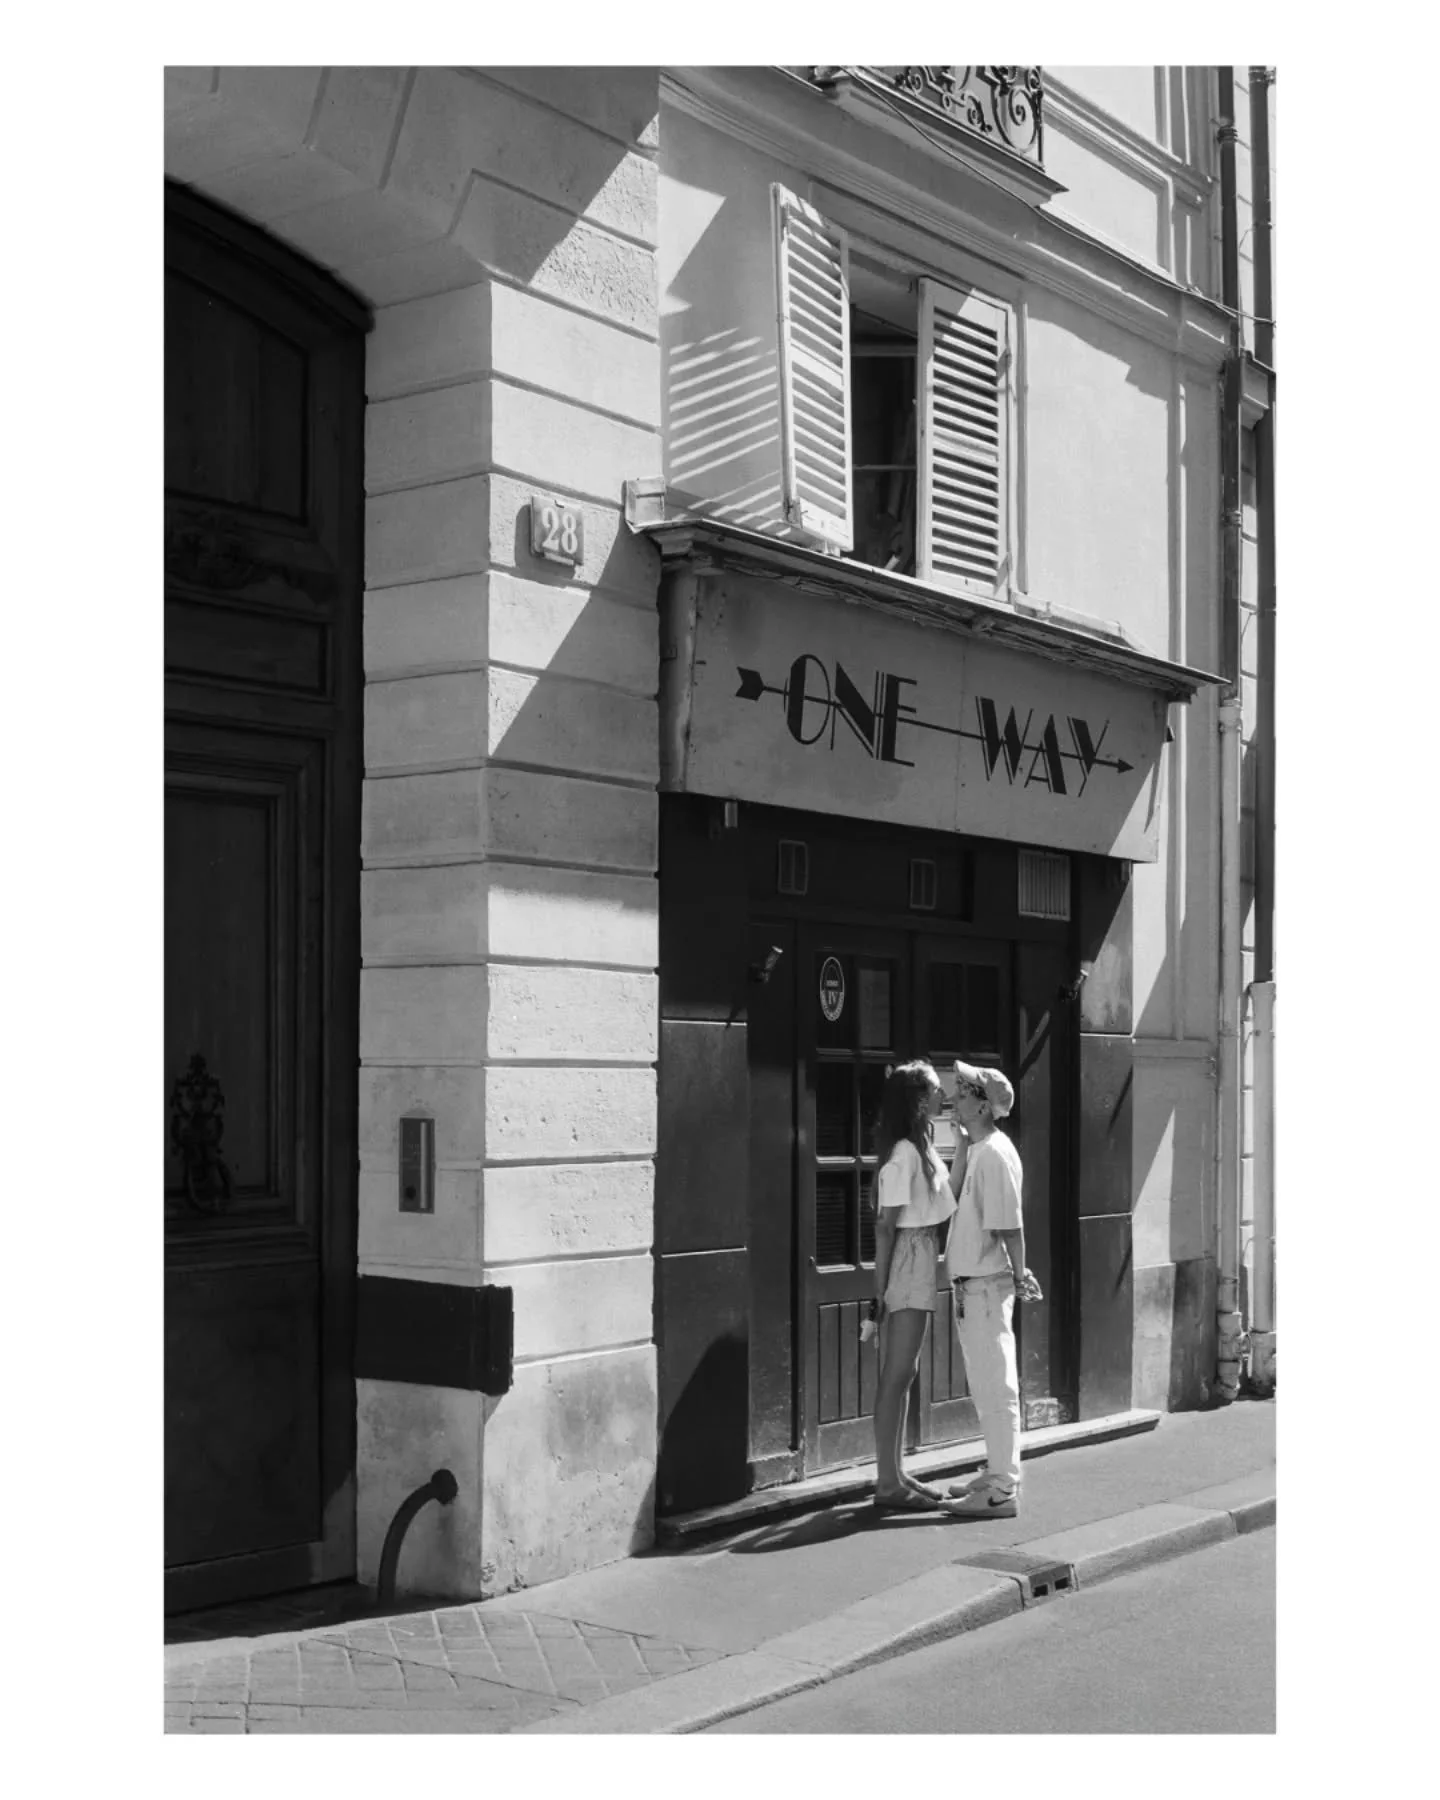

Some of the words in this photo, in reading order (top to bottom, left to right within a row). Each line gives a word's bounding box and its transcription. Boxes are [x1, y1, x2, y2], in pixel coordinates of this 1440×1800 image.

[541, 507, 578, 554] 28
[784, 654, 917, 767] ONE
[975, 696, 1110, 797] WAY
